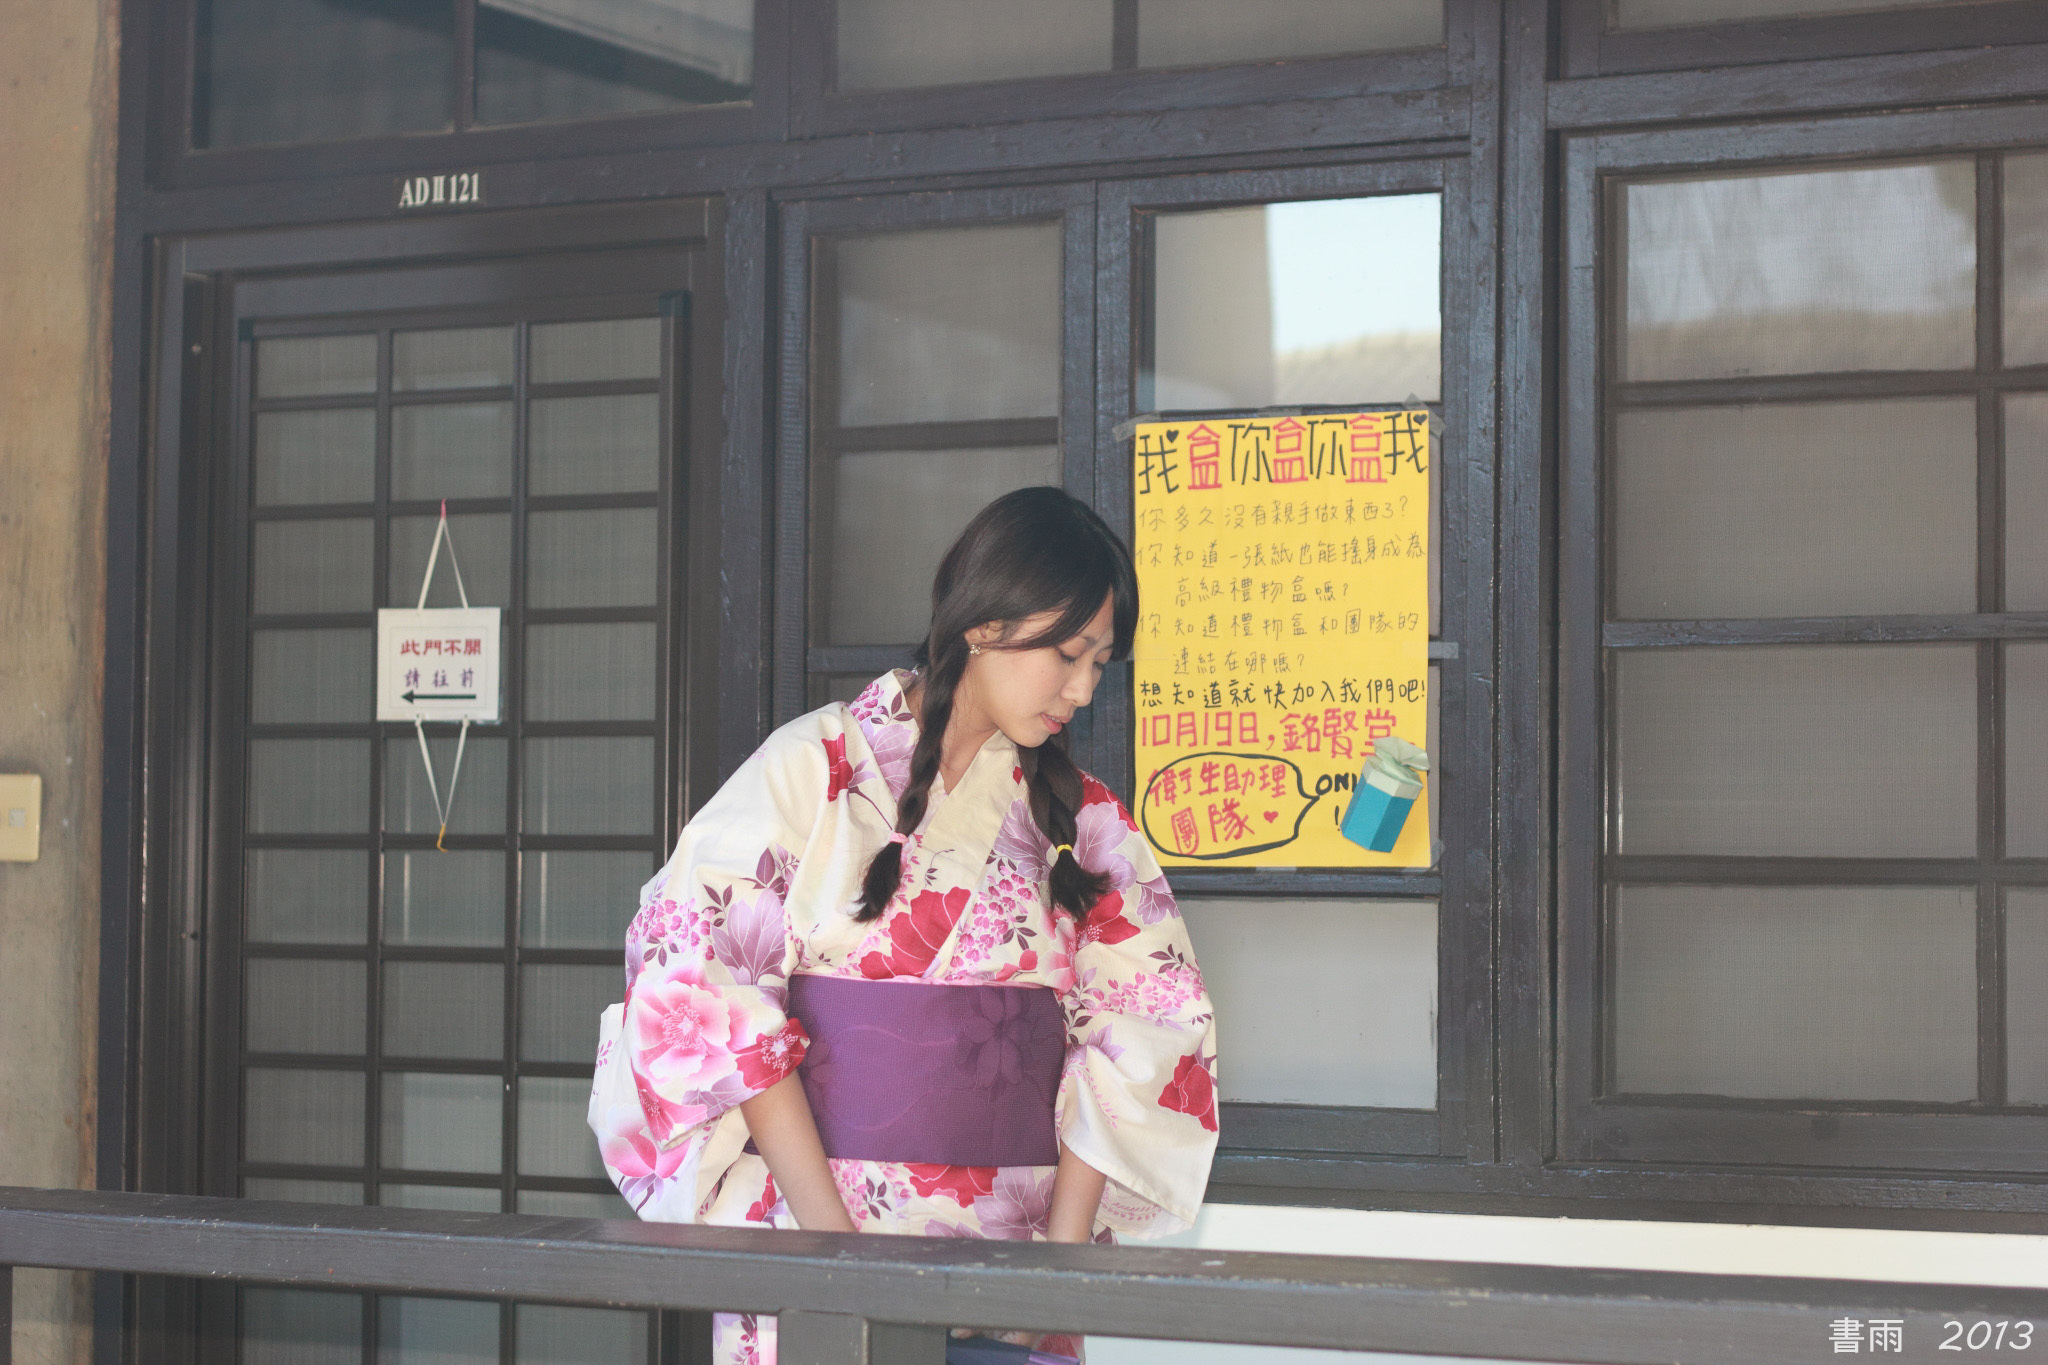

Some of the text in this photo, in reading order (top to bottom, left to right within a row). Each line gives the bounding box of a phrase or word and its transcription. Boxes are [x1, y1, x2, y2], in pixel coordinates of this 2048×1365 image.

[1138, 412, 1428, 494] 我盒你盒你盒我
[1137, 607, 1419, 642] 你知道禮物盒和團隊的
[400, 638, 482, 656] 此門不開
[1140, 678, 1426, 709] 想知道就快加入我們吧!
